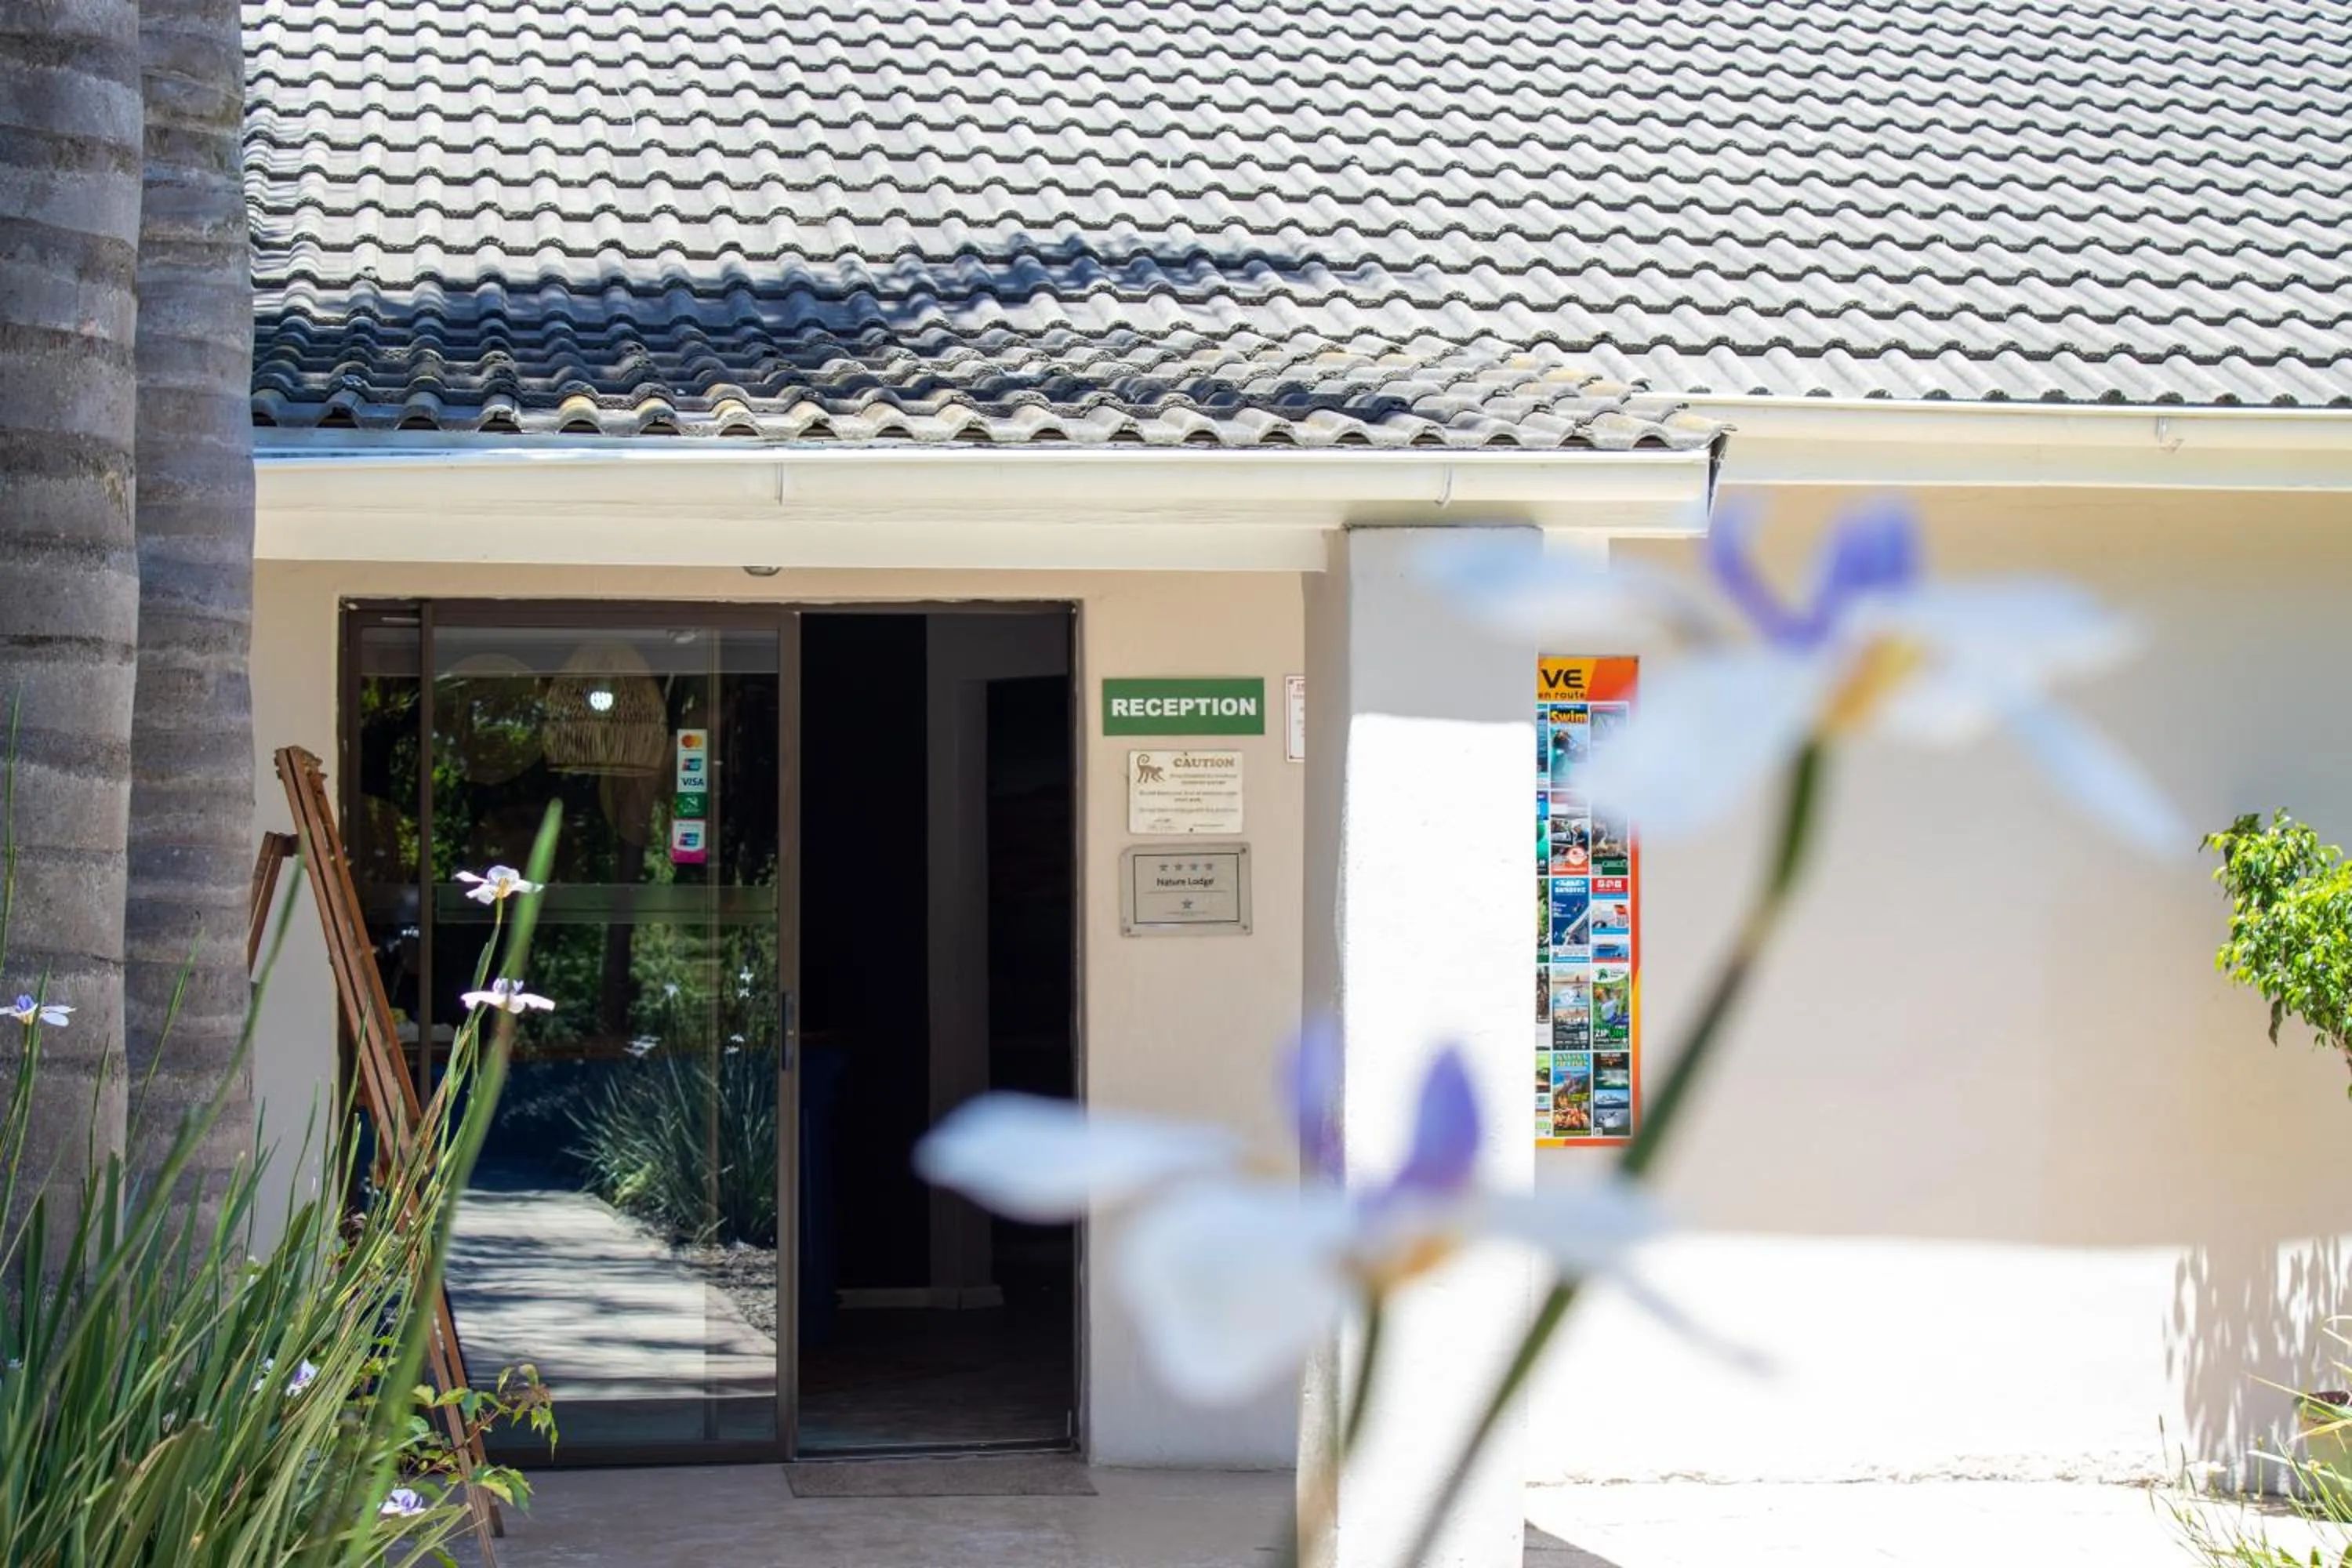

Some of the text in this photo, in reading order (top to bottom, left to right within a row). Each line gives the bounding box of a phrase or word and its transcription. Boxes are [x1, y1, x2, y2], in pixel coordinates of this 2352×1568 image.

[1555, 691, 1585, 699] route
[1112, 698, 1257, 717] RECEPTION
[1550, 710, 1588, 724] Swim
[1173, 757, 1235, 768] CAUTION
[681, 777, 704, 786] VISA
[1156, 877, 1214, 887] Nature Lodge
